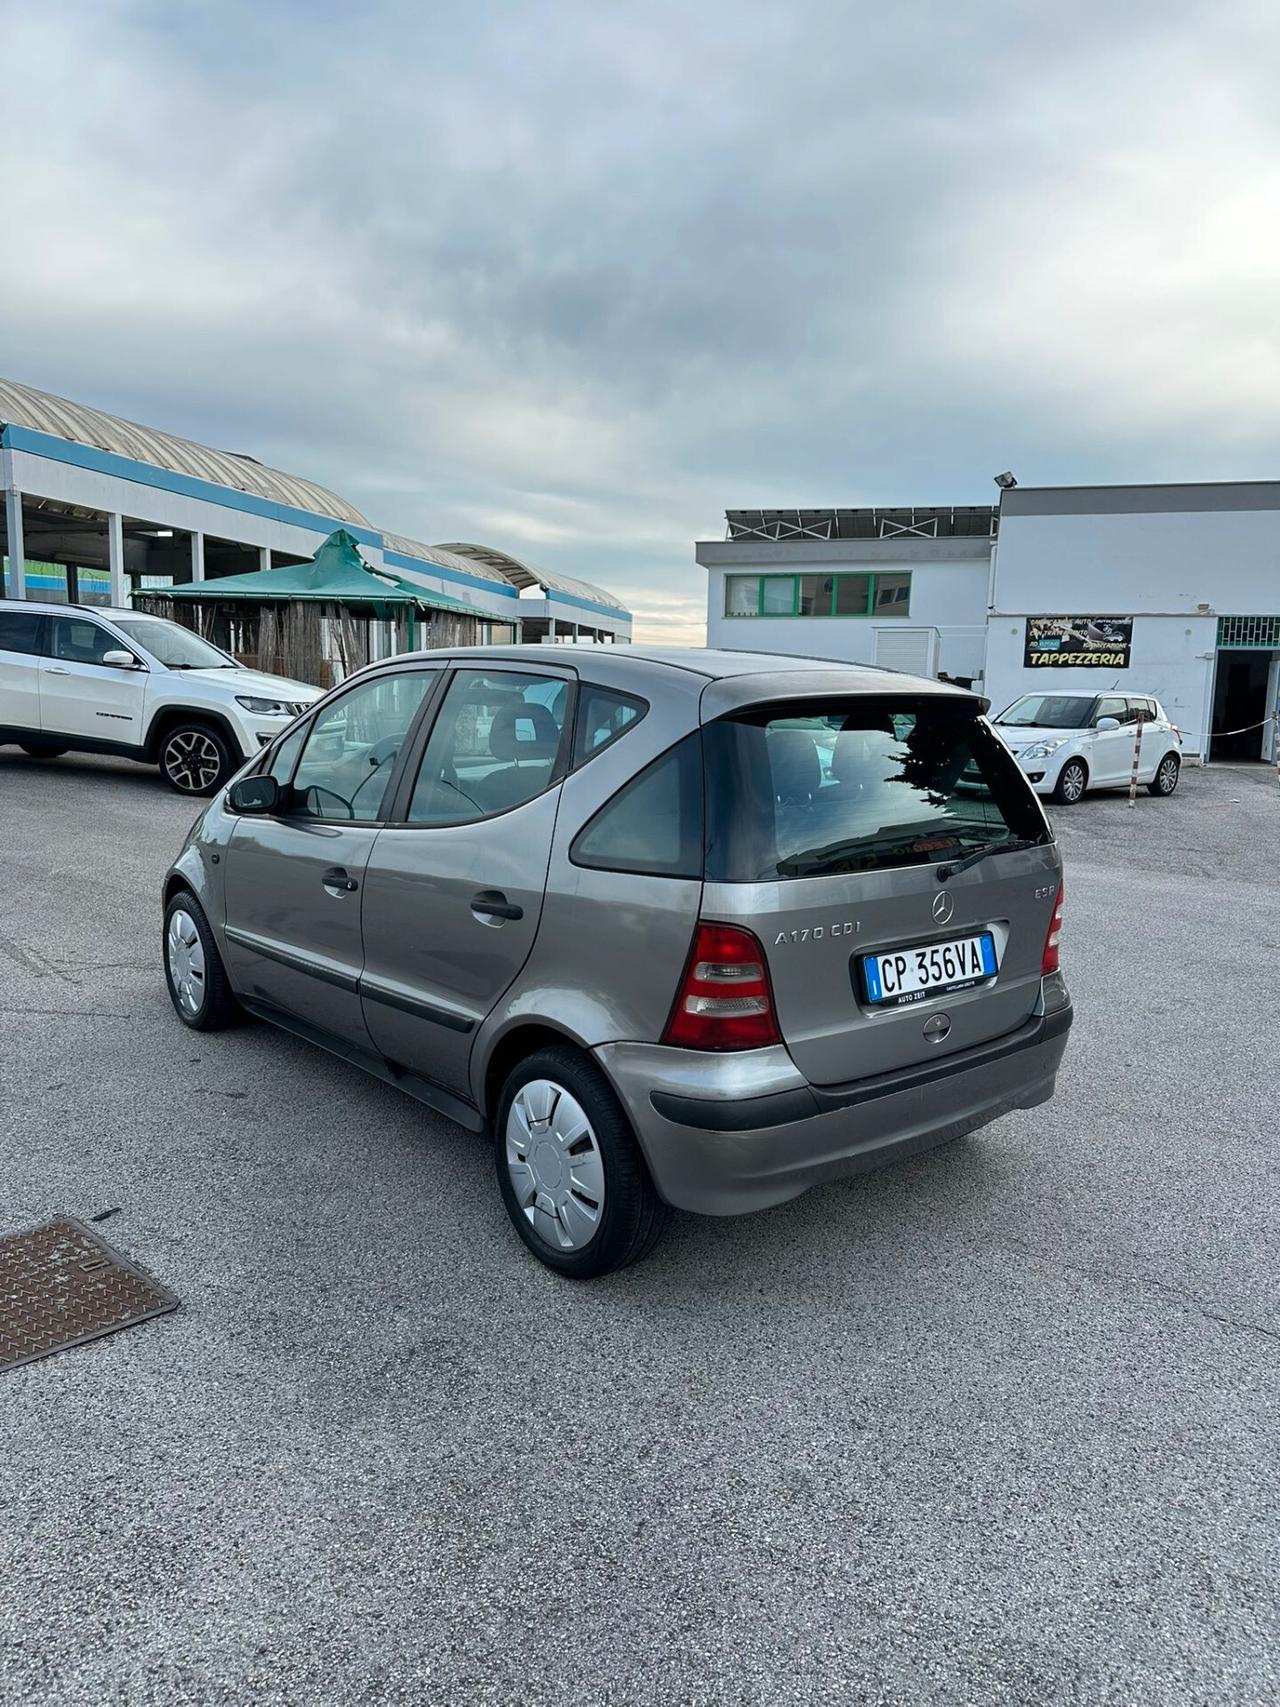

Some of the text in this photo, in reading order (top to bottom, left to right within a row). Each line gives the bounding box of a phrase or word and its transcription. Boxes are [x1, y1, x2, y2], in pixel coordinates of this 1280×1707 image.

[1030, 652, 1125, 665] TAPPEZZERIA
[1034, 885, 1055, 899] ESP
[774, 921, 861, 945] A170 CDI
[882, 956, 907, 993] CP
[915, 941, 982, 985] 356VA
[898, 991, 926, 1004] AUTO ZEIT
